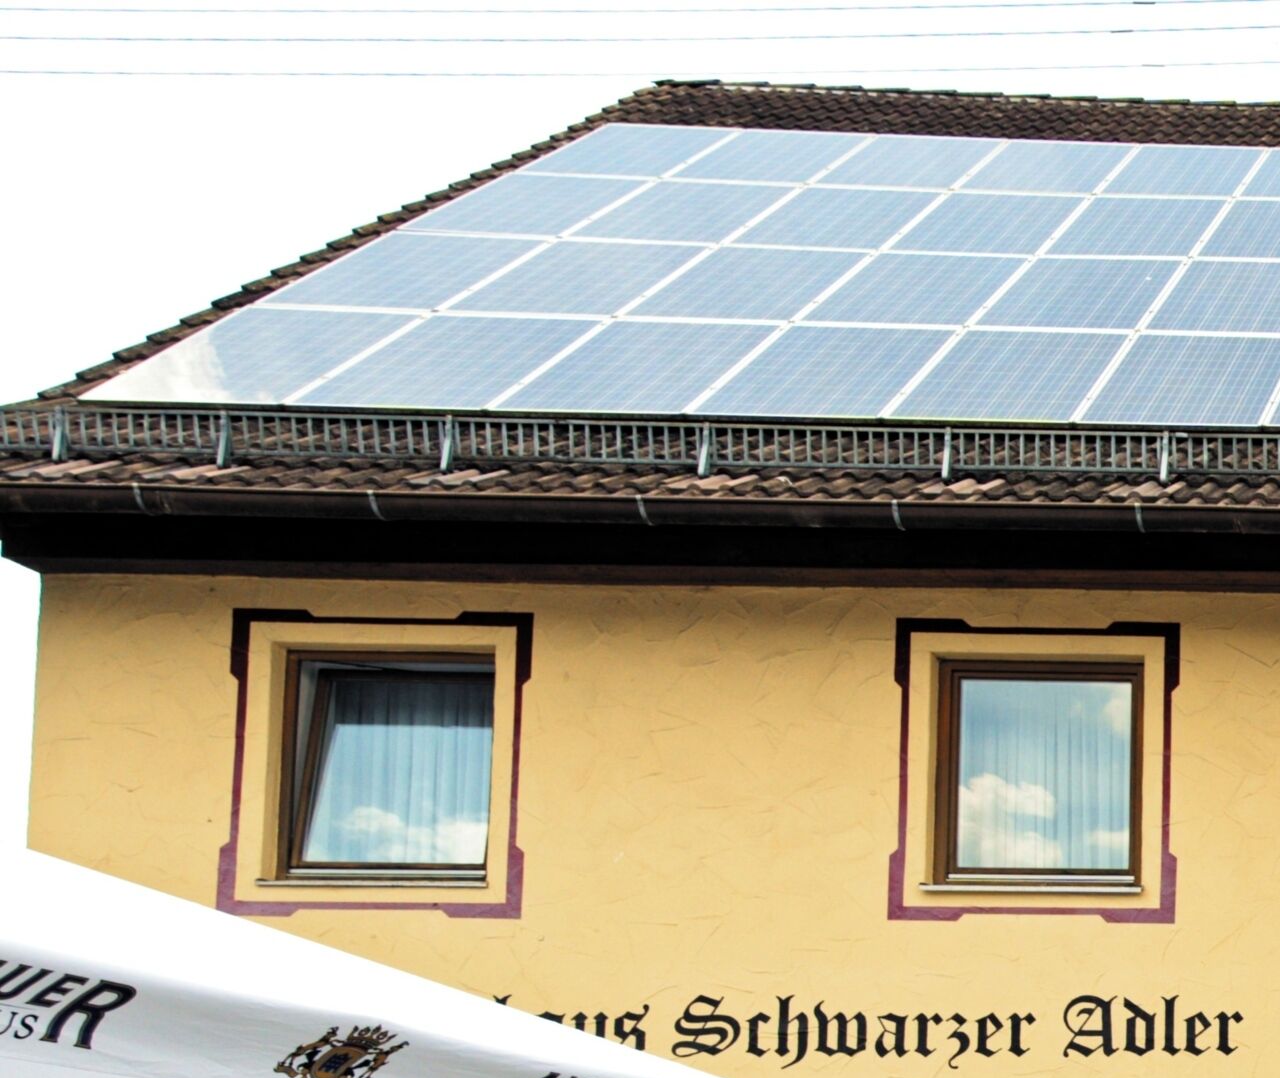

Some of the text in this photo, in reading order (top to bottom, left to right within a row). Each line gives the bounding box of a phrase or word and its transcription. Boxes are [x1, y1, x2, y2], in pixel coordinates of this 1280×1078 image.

[0, 959, 137, 1049] UER
[671, 994, 1036, 1069] Schwarzer
[1063, 994, 1244, 1058] Adler
